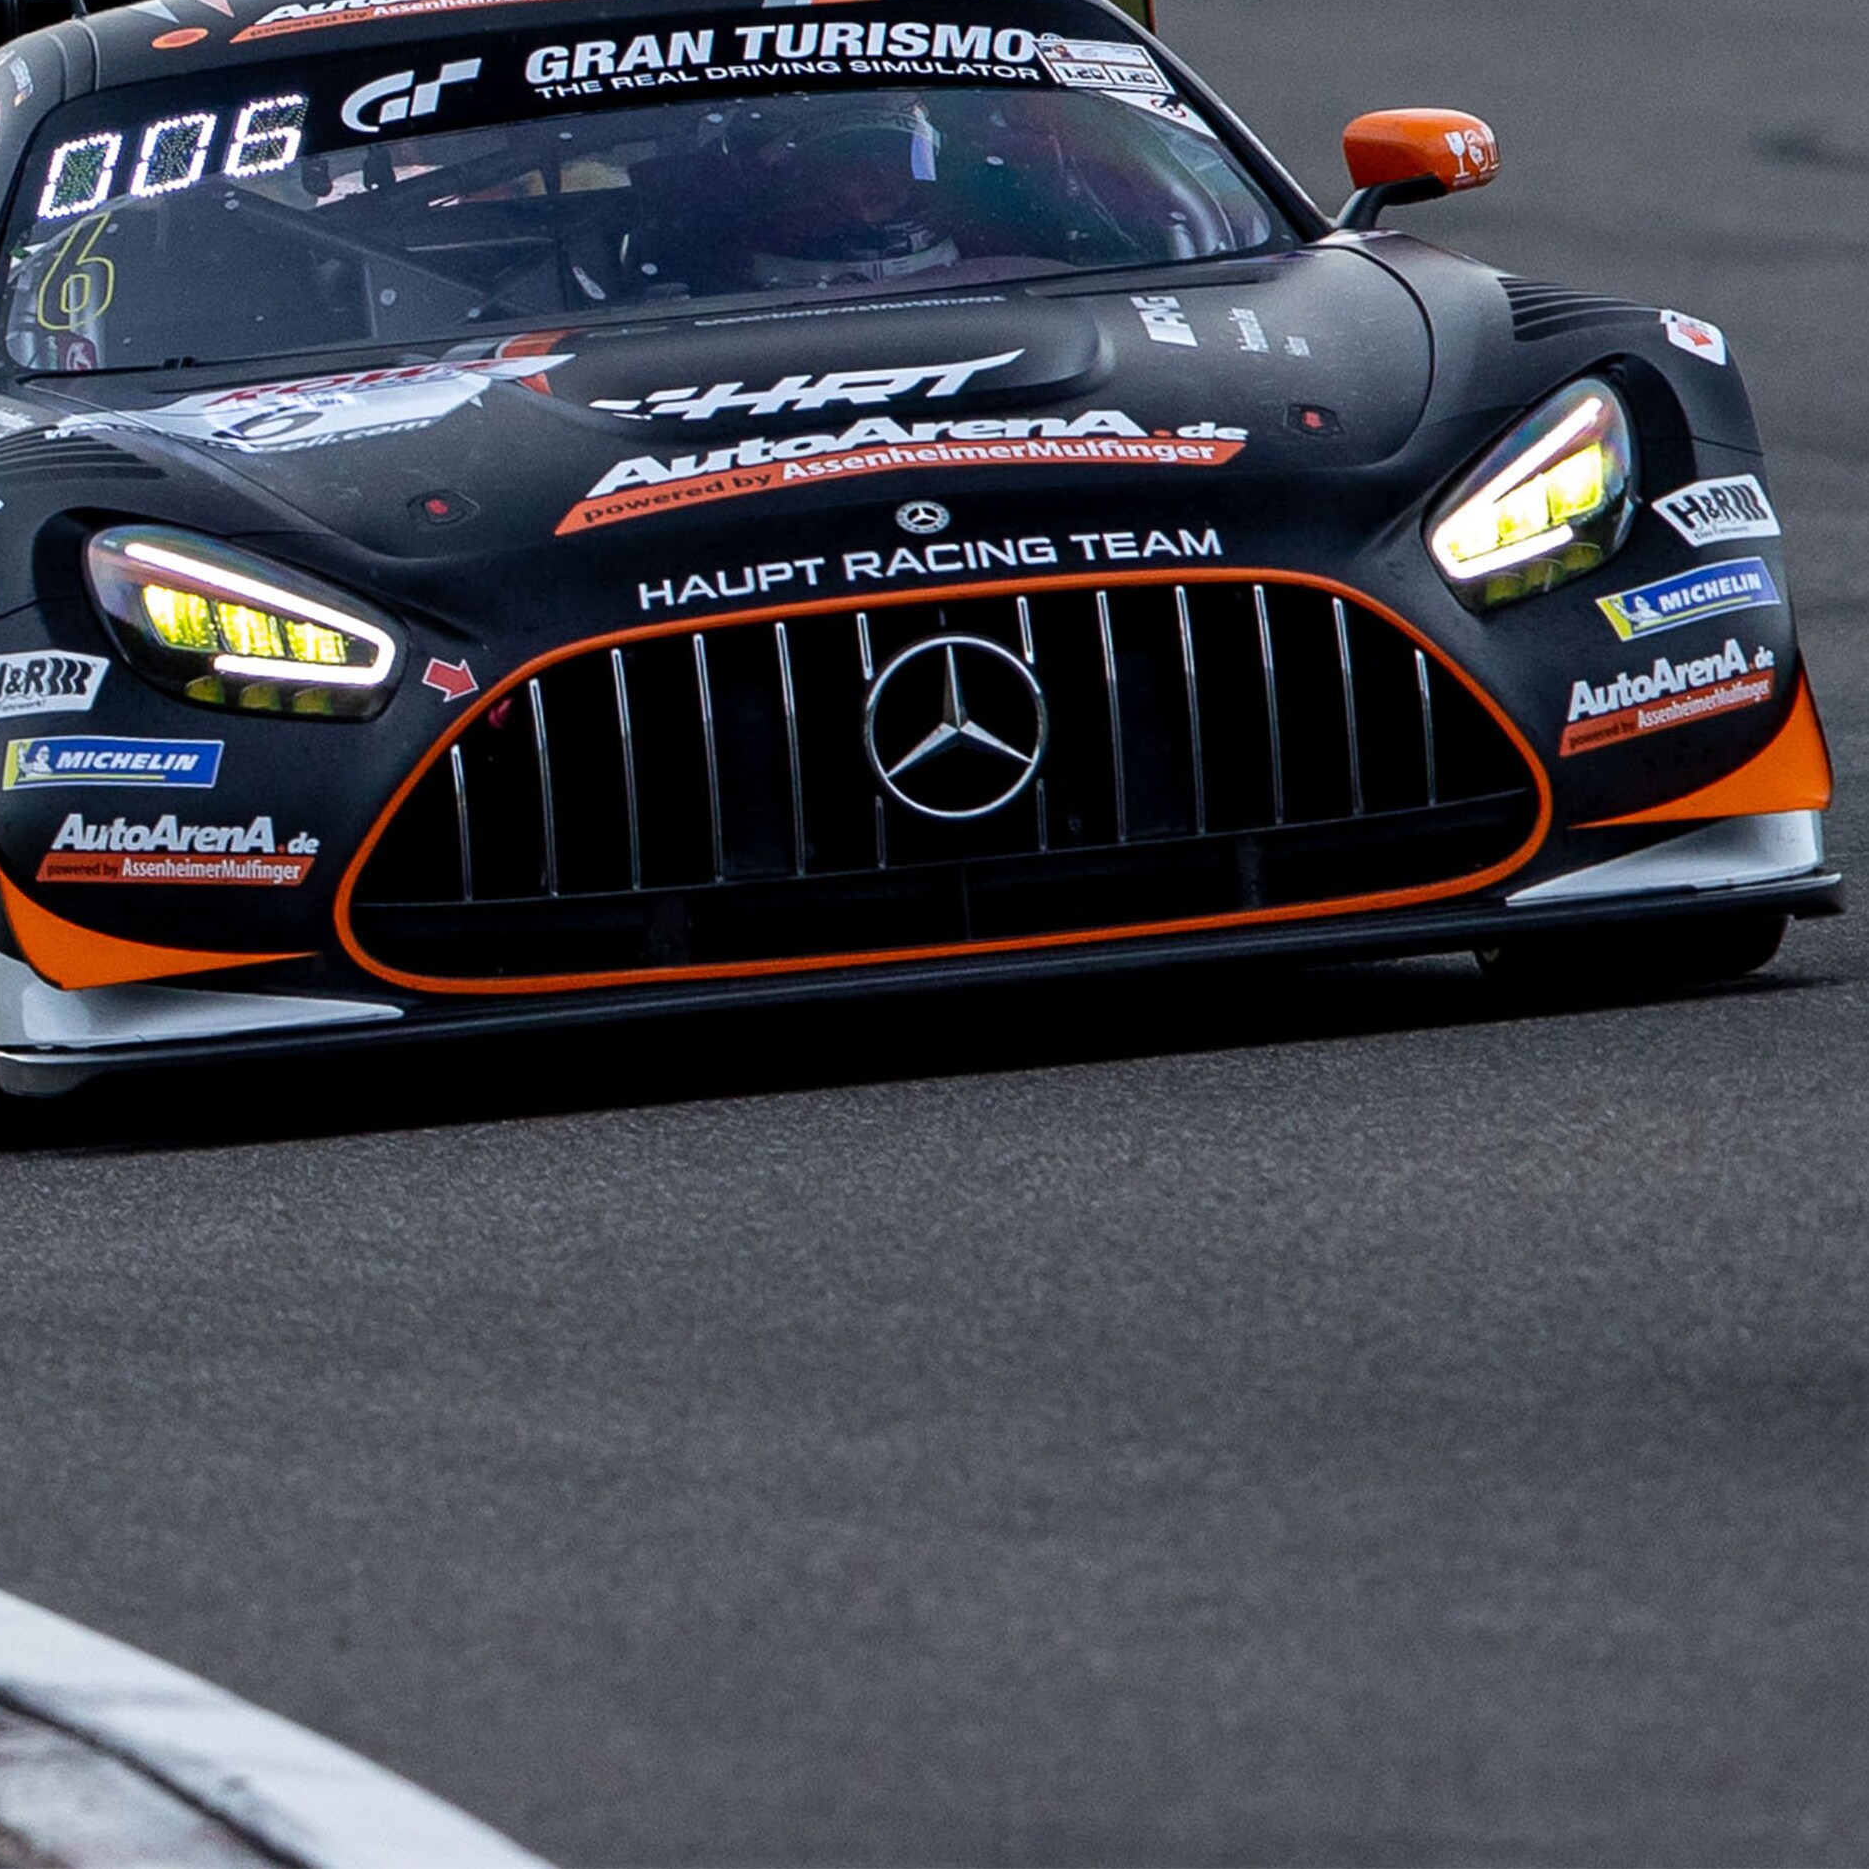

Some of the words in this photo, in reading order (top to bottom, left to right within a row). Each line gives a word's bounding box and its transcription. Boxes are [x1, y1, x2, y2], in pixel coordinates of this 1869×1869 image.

[525, 29, 714, 84] GRAN
[735, 21, 1036, 63] TURISMO
[535, 80, 603, 100] THE
[611, 69, 699, 91] REAL
[705, 60, 842, 81] DRIVING
[851, 59, 1040, 82] SIMULATOR
[38, 94, 303, 219] 006
[37, 211, 115, 331] 6
[583, 481, 726, 523] powered
[732, 473, 772, 489] by
[782, 439, 1216, 481] AssenheimerMulfinger
[637, 557, 825, 610] HAUPT
[844, 536, 1058, 582] RACING
[1069, 528, 1224, 562] TEAM
[1659, 572, 1762, 613] MICHELIN
[1636, 677, 1771, 729] AssenheimerMulfinger
[55, 750, 200, 772] MICHELIN
[46, 860, 101, 879] powered
[121, 857, 301, 884] AssenheimerMulfinger
